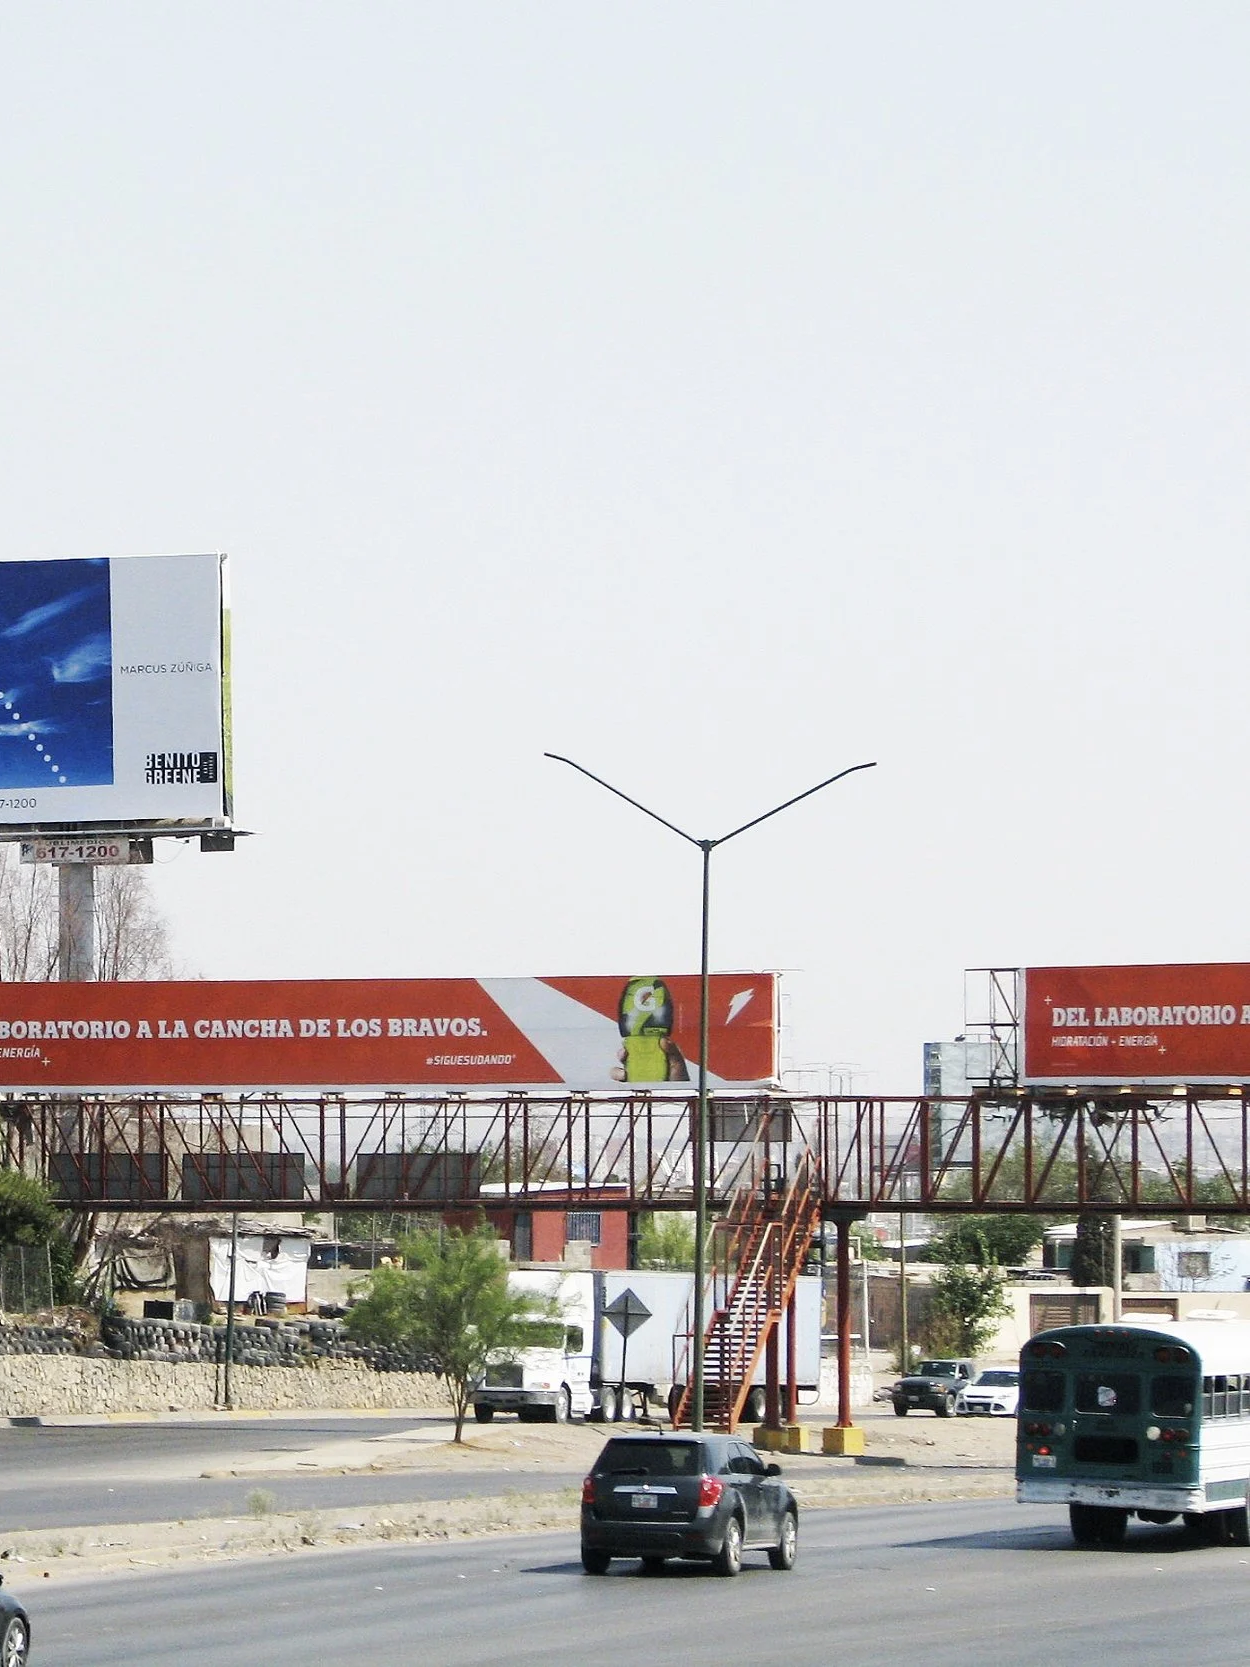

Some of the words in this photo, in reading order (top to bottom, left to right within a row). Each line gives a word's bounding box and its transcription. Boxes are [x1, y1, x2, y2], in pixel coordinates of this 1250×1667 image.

[120, 664, 167, 674] MARCUS
[170, 661, 212, 673] ZÚÑIGA
[146, 751, 200, 768] BENITO
[145, 768, 200, 783] GREENE
[36, 845, 120, 859] 617-1200
[1052, 1007, 1090, 1026] DEL
[1094, 1005, 1236, 1026] LABORATORIO
[136, 1020, 153, 1038] A
[157, 1020, 189, 1038] LA
[193, 1019, 294, 1038] CANCHA
[298, 1019, 330, 1038] DE
[337, 1018, 382, 1037] LOS
[387, 1017, 487, 1037] BRAVOS.
[1051, 1032, 1109, 1047] HIDRATACIÓN
[1119, 1032, 1158, 1047] ENERGÍA
